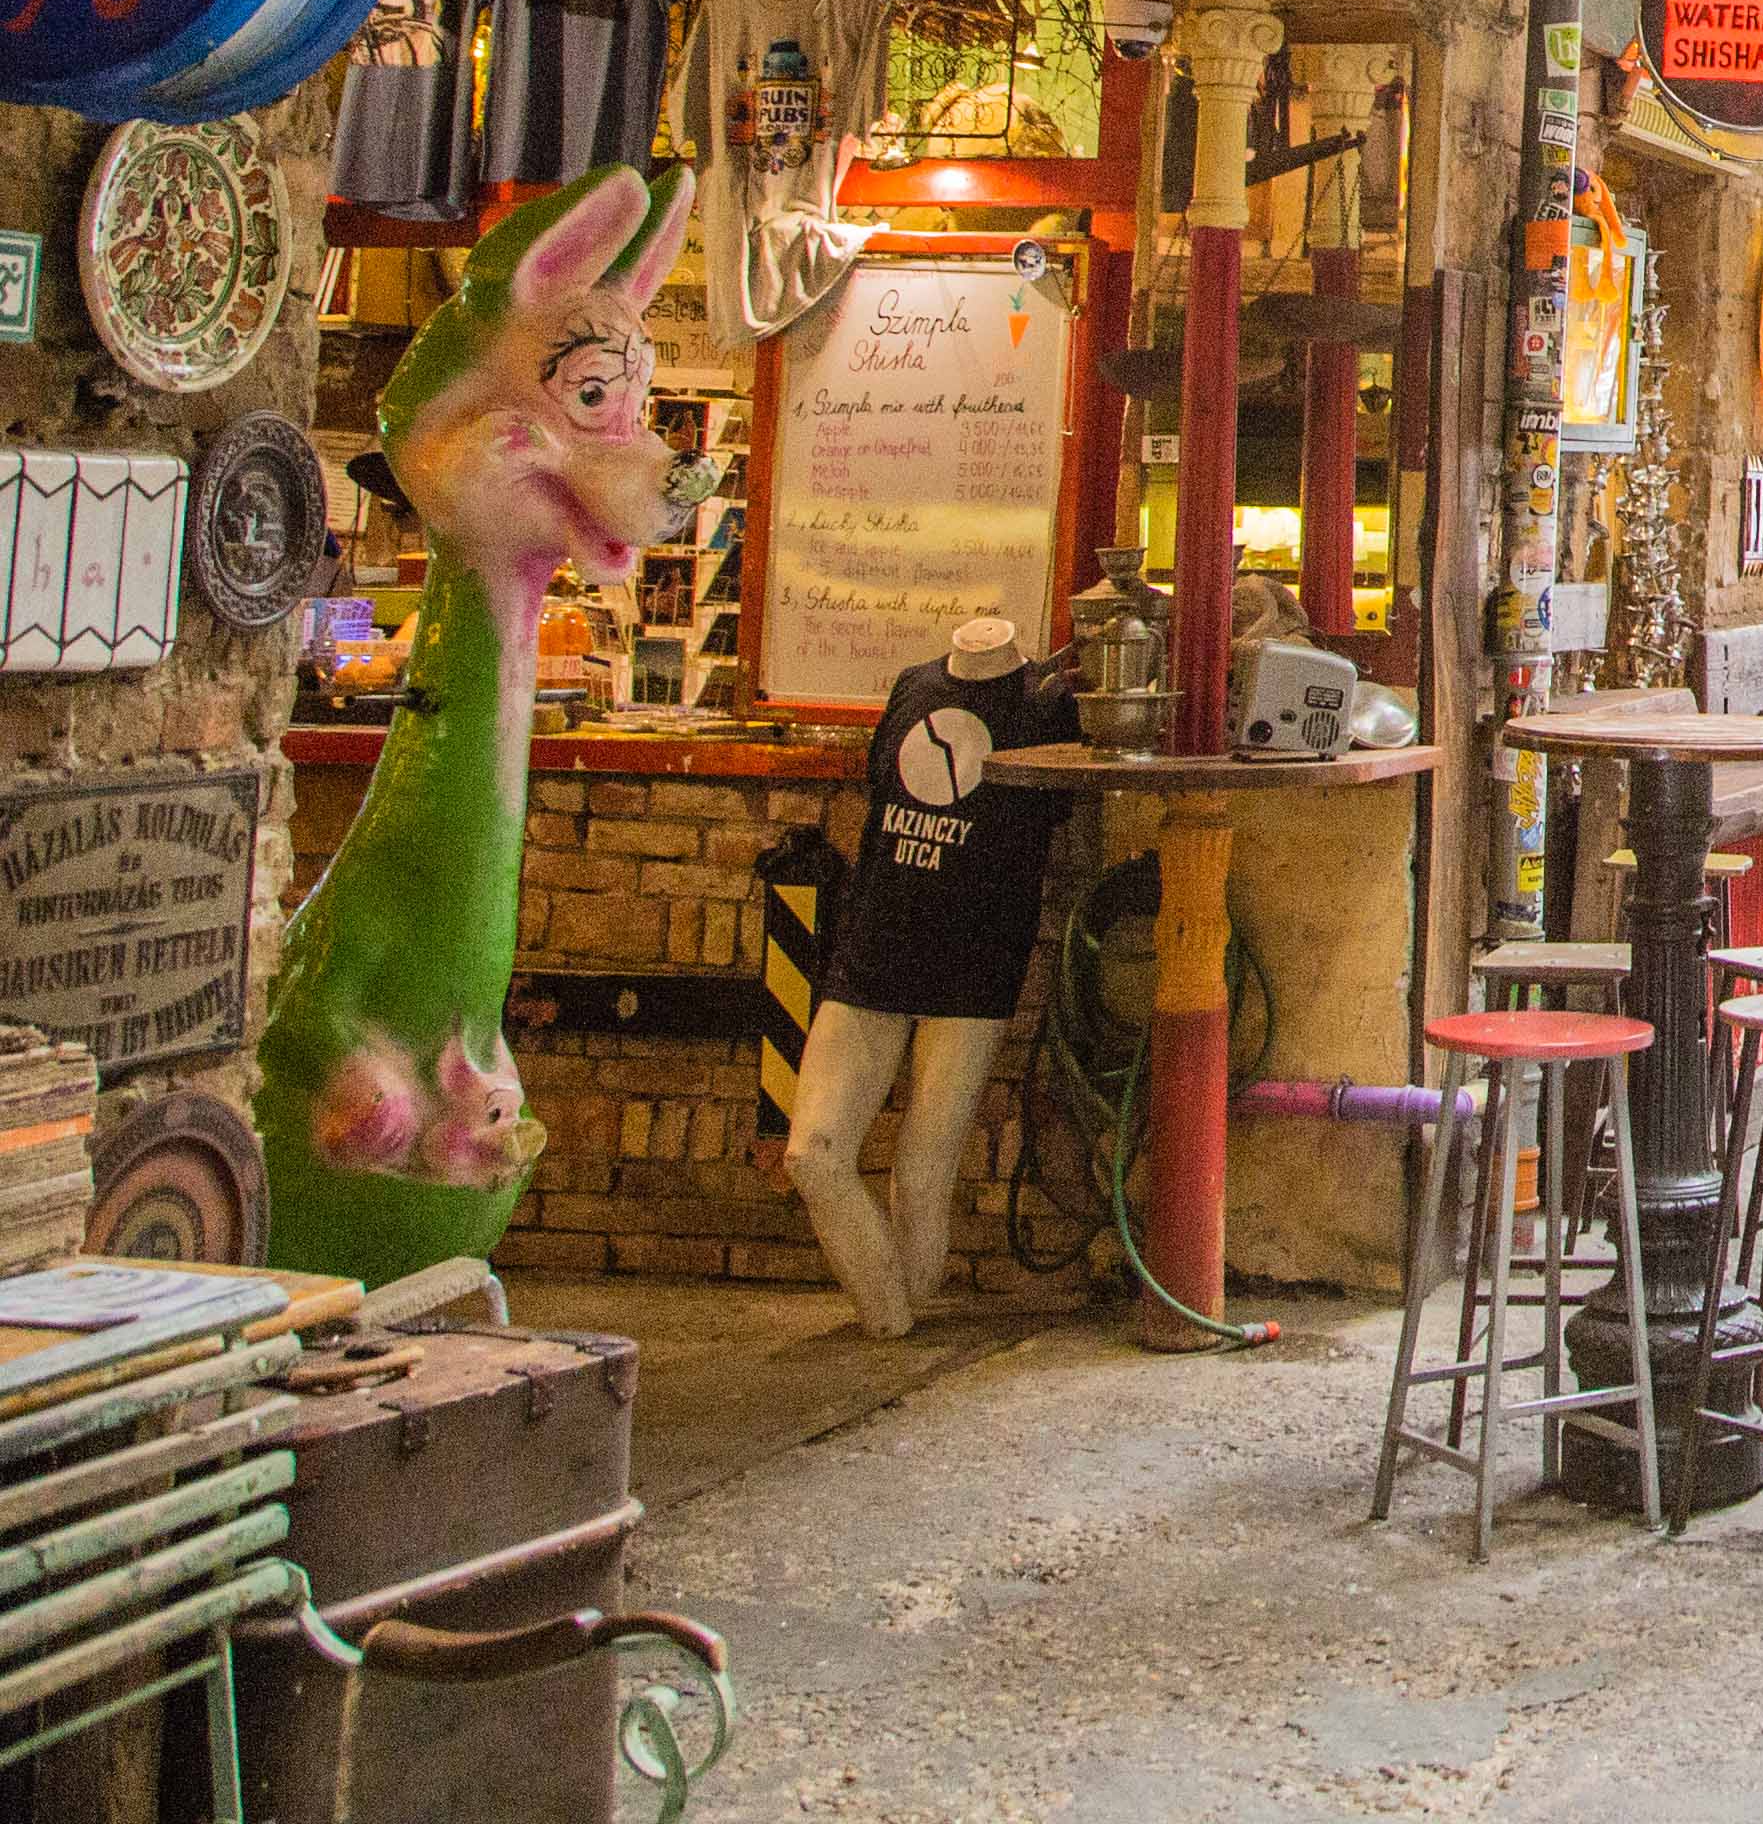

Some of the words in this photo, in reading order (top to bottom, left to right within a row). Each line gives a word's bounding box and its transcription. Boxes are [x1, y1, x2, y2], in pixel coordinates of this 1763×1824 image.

[760, 89, 809, 106] RUIN
[759, 107, 809, 124] PUBS
[869, 288, 972, 349] Szimpla
[848, 339, 928, 373] Shisha
[811, 388, 873, 421] Szimpla
[912, 393, 946, 415] with
[816, 421, 850, 444] Apple
[810, 509, 856, 539] Lucky
[862, 508, 919, 532] Shisha
[805, 586, 868, 612] Shisha
[881, 802, 973, 847] KAZINCZY
[894, 839, 943, 872] UTCA
